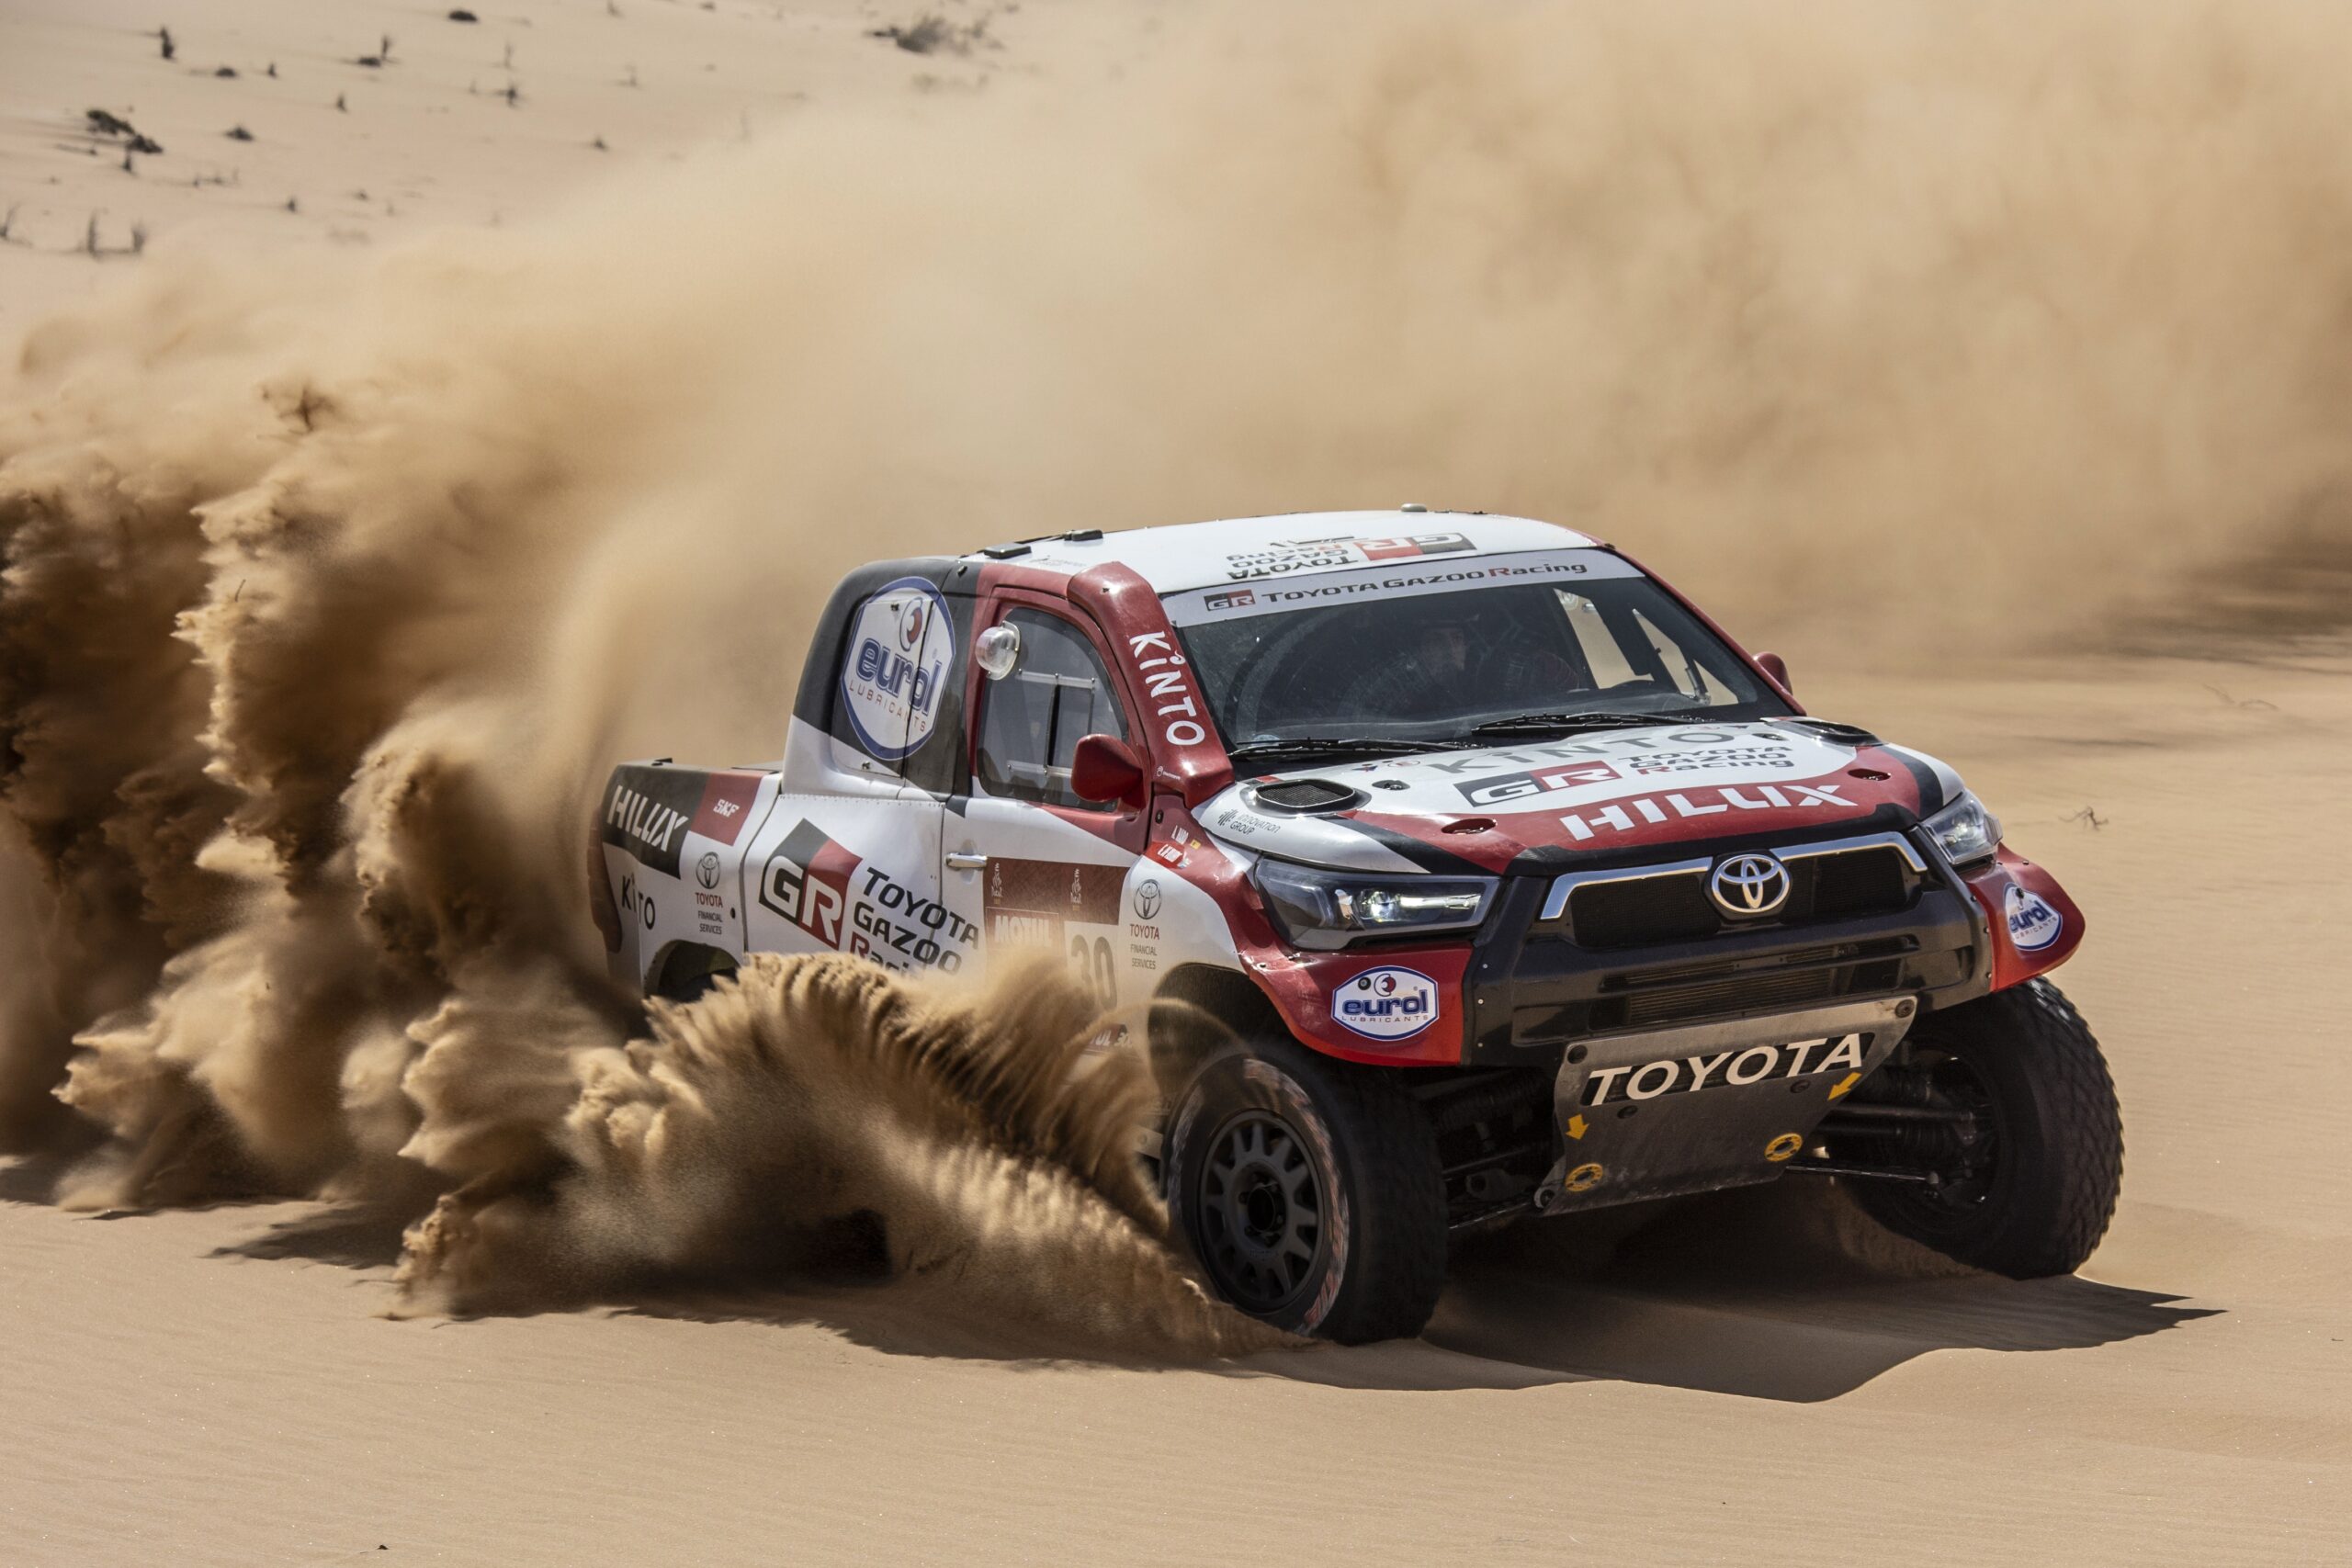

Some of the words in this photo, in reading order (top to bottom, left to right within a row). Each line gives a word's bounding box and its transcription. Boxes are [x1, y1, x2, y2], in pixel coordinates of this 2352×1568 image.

[1227, 556, 1358, 580] TOYOTA
[1232, 548, 1349, 568] GAZOO
[1206, 594, 1254, 610] GR
[1261, 582, 1379, 603] TOYOTA
[1383, 571, 1484, 589] GAZOO
[1487, 563, 1588, 577] Racing
[856, 637, 942, 716] eurol
[849, 681, 926, 732] LUBRICANTS
[1617, 745, 1793, 762] TOYOTA
[1630, 752, 1787, 769] GAZOO
[1637, 760, 1794, 775] Racing
[1470, 767, 1614, 804] GR
[606, 784, 689, 852] HILUX
[713, 798, 740, 818] SKF
[1560, 784, 1859, 840] HILUX
[1229, 820, 1256, 835] GROUP
[695, 892, 723, 908] TOYOTA
[763, 855, 843, 945] GR
[864, 866, 978, 950] TOYOTA
[698, 910, 723, 922] FINANCIAL
[2009, 900, 2052, 933] eurol
[699, 923, 722, 935] SERVICES
[854, 901, 962, 976] GAZOO
[1130, 924, 1159, 940] TOYOTA
[1130, 944, 1158, 956] FINANCIAL
[1071, 934, 1117, 1011] 30
[1132, 957, 1156, 970] SERVICES
[1342, 989, 1430, 1017] eurol
[1341, 1015, 1429, 1023] LUBRICANTS
[1588, 1033, 1863, 1106] TOYOTA
